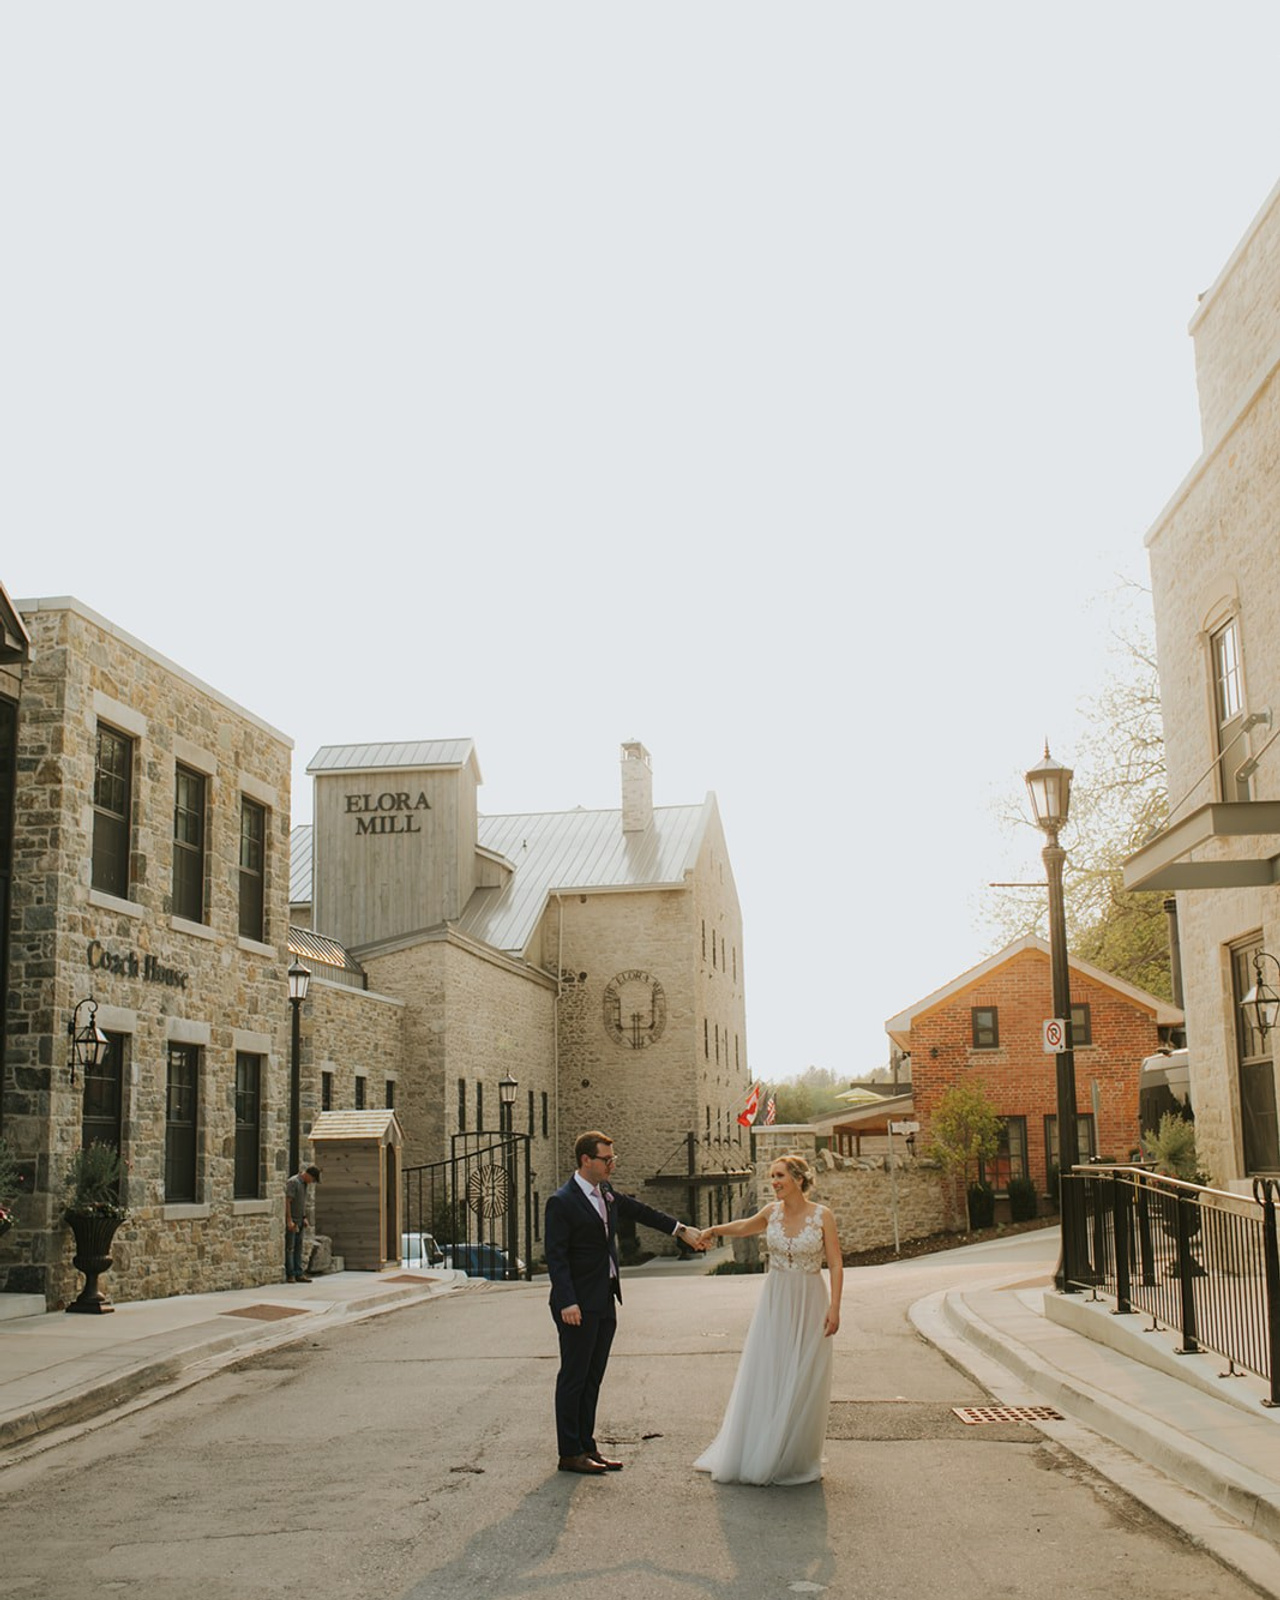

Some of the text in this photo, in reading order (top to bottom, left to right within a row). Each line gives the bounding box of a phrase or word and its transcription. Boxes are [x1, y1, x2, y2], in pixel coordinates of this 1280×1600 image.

[344, 791, 431, 813] ELORA
[355, 814, 421, 835] MILL
[87, 940, 189, 991] Coach House
